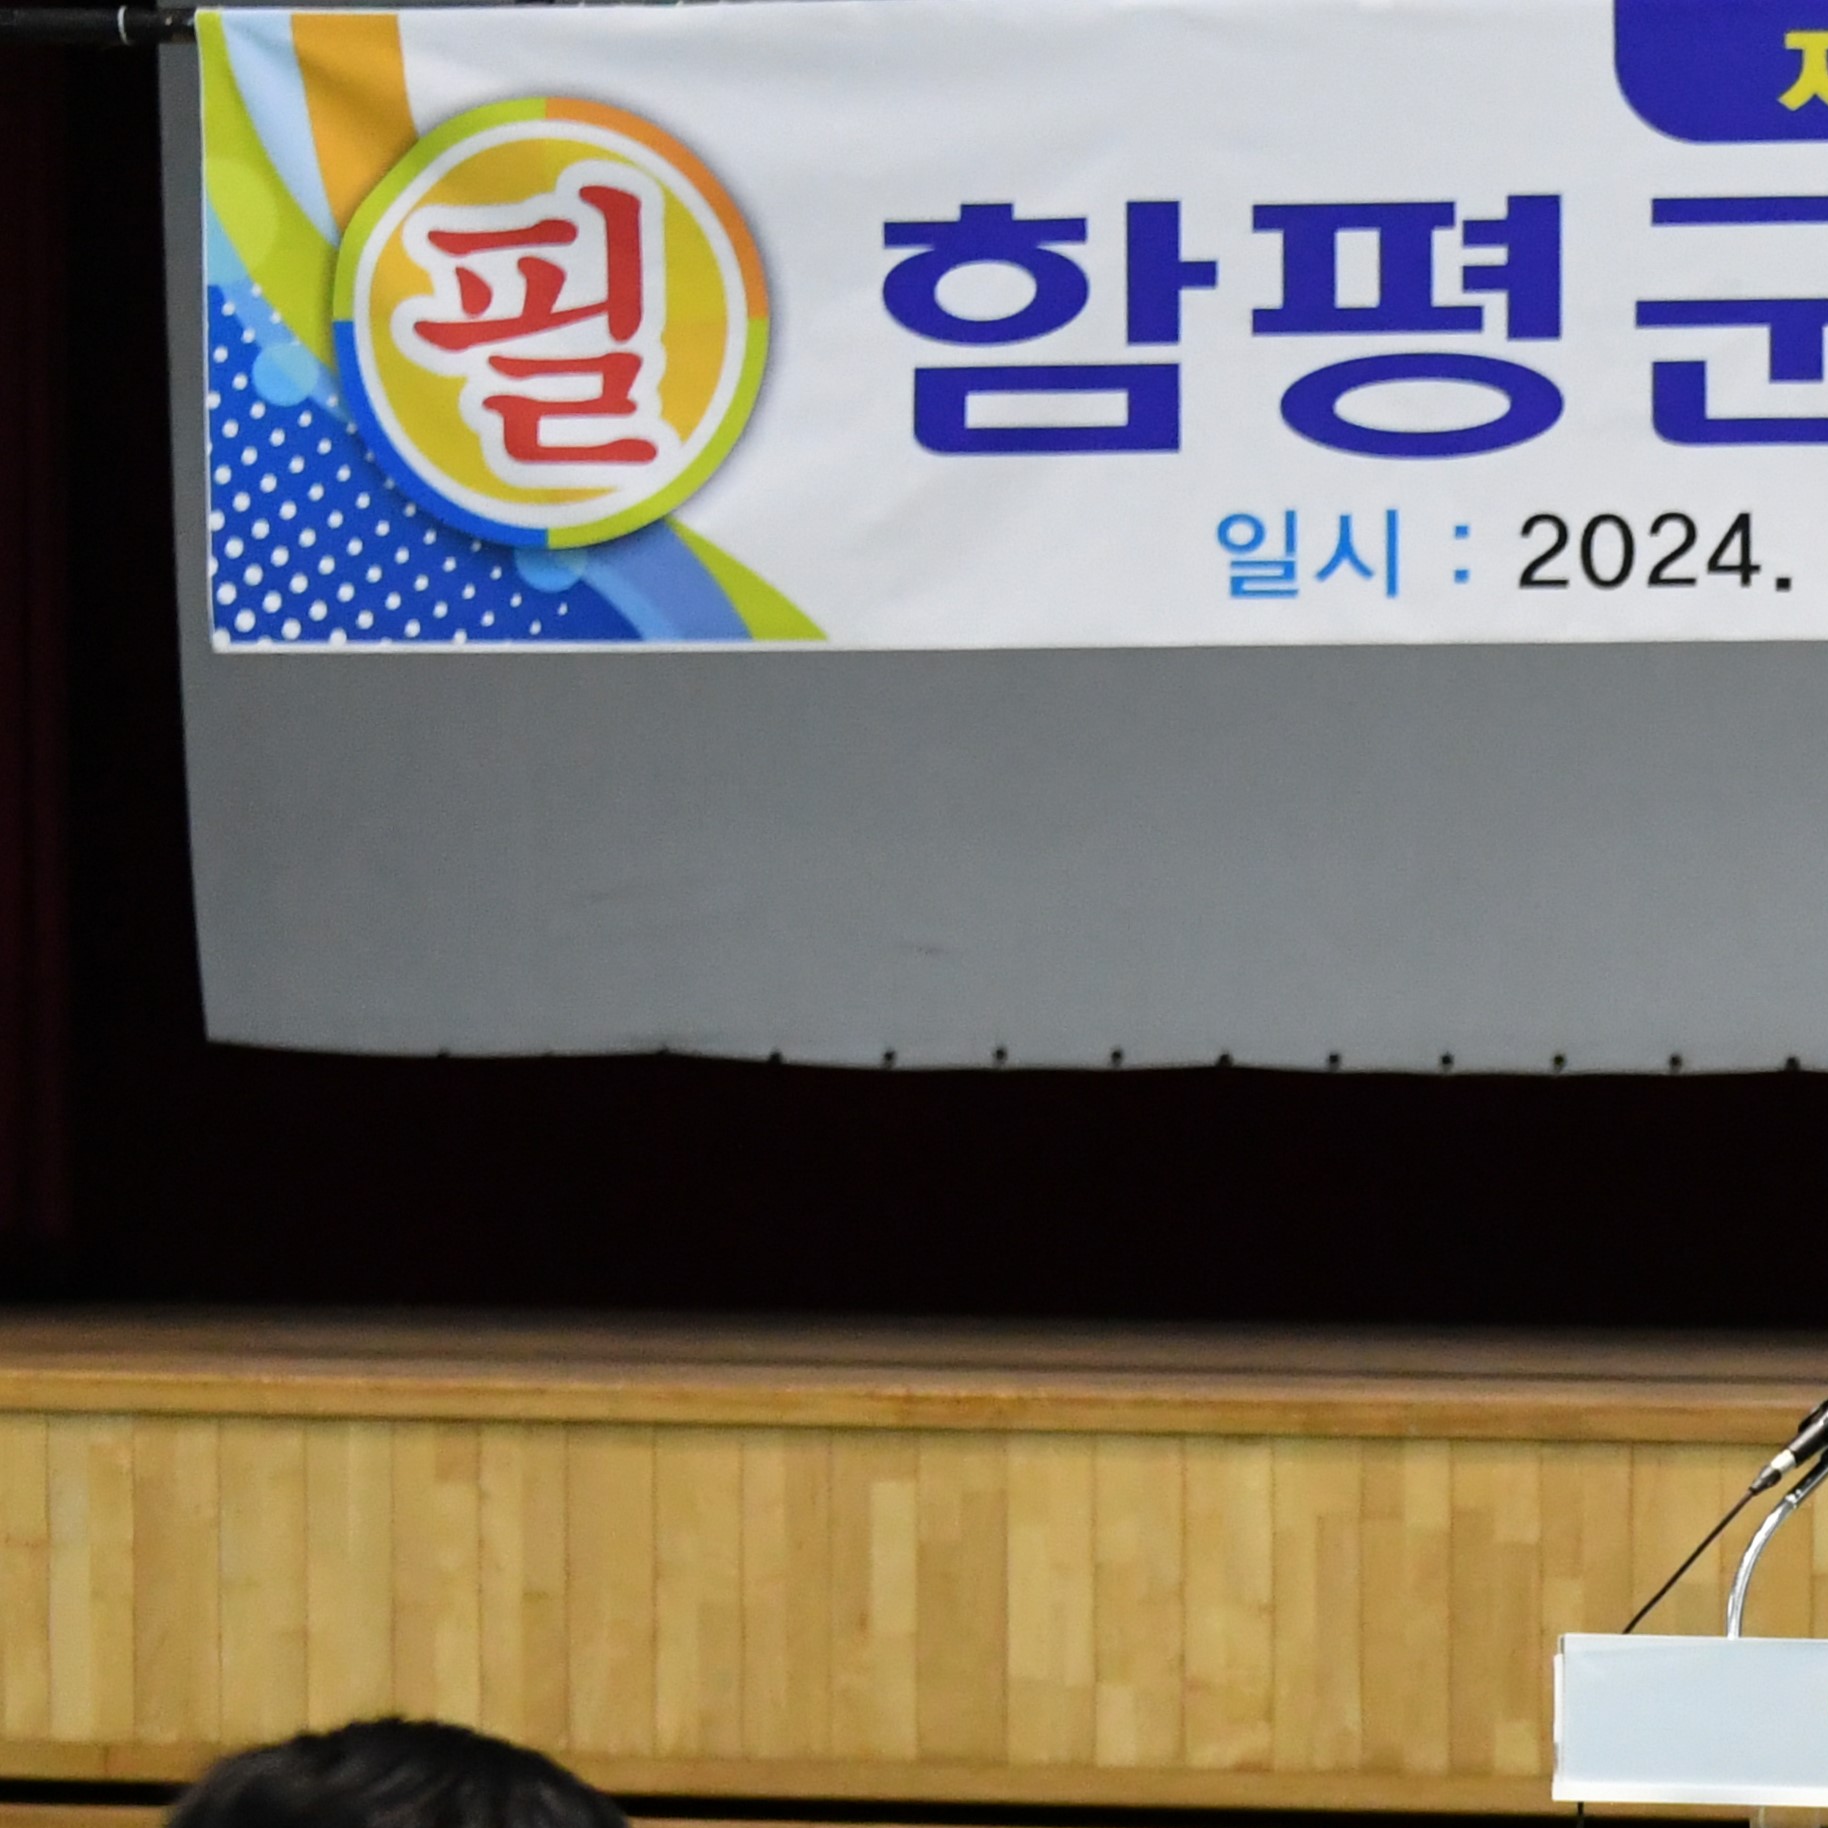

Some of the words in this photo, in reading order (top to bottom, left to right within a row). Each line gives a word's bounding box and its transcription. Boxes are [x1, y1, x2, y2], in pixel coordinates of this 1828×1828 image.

[412, 184, 660, 467] 필
[1215, 508, 1401, 601] 일시
[1518, 509, 1792, 592] 2024.
